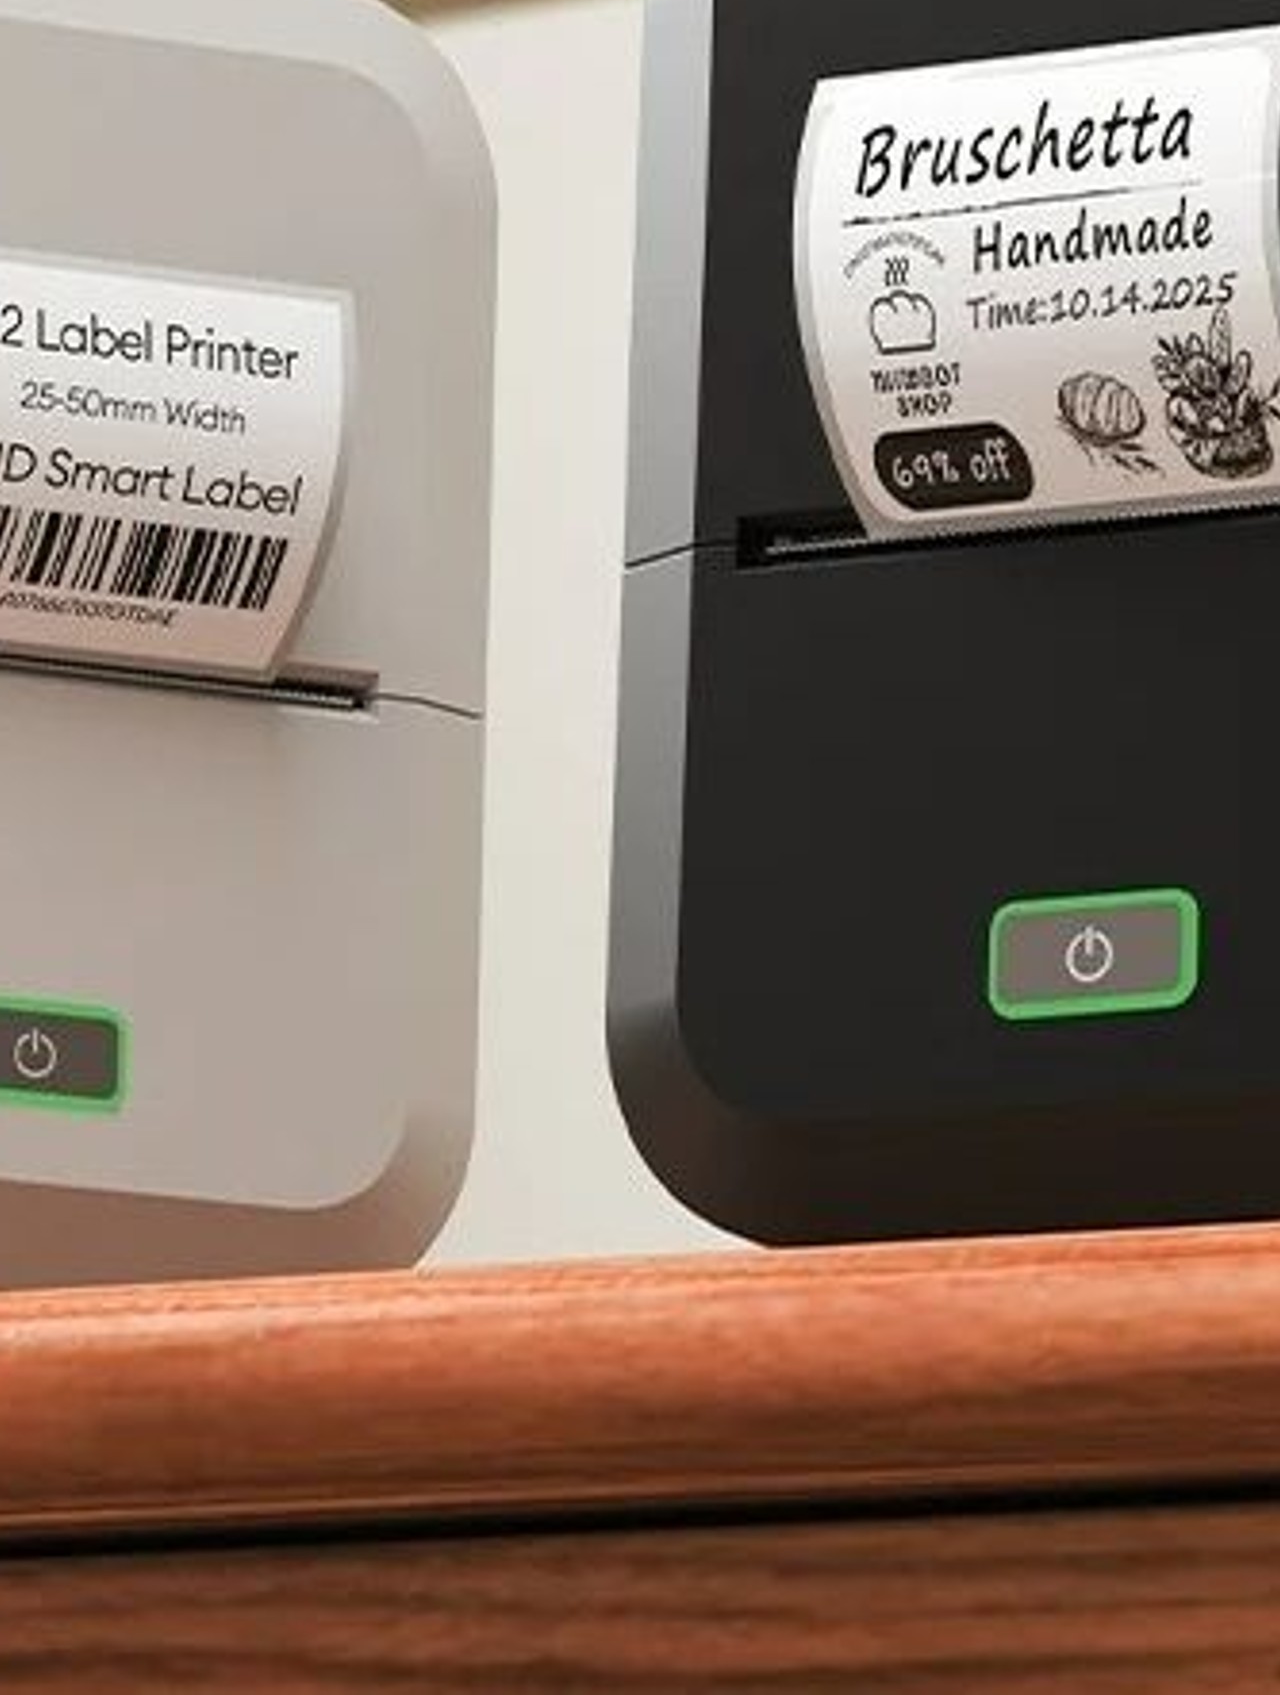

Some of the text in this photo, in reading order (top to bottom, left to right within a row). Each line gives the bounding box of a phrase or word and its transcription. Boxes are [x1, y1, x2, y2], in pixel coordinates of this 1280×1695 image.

[854, 97, 1194, 198] Bruschetta
[971, 197, 1214, 274] Handmade
[34, 308, 154, 363] Label
[165, 323, 300, 380] Printer
[19, 380, 247, 437] 25-50mm Width
[43, 446, 176, 502] Smart
[181, 469, 303, 517] Label
[969, 438, 1012, 483] off
